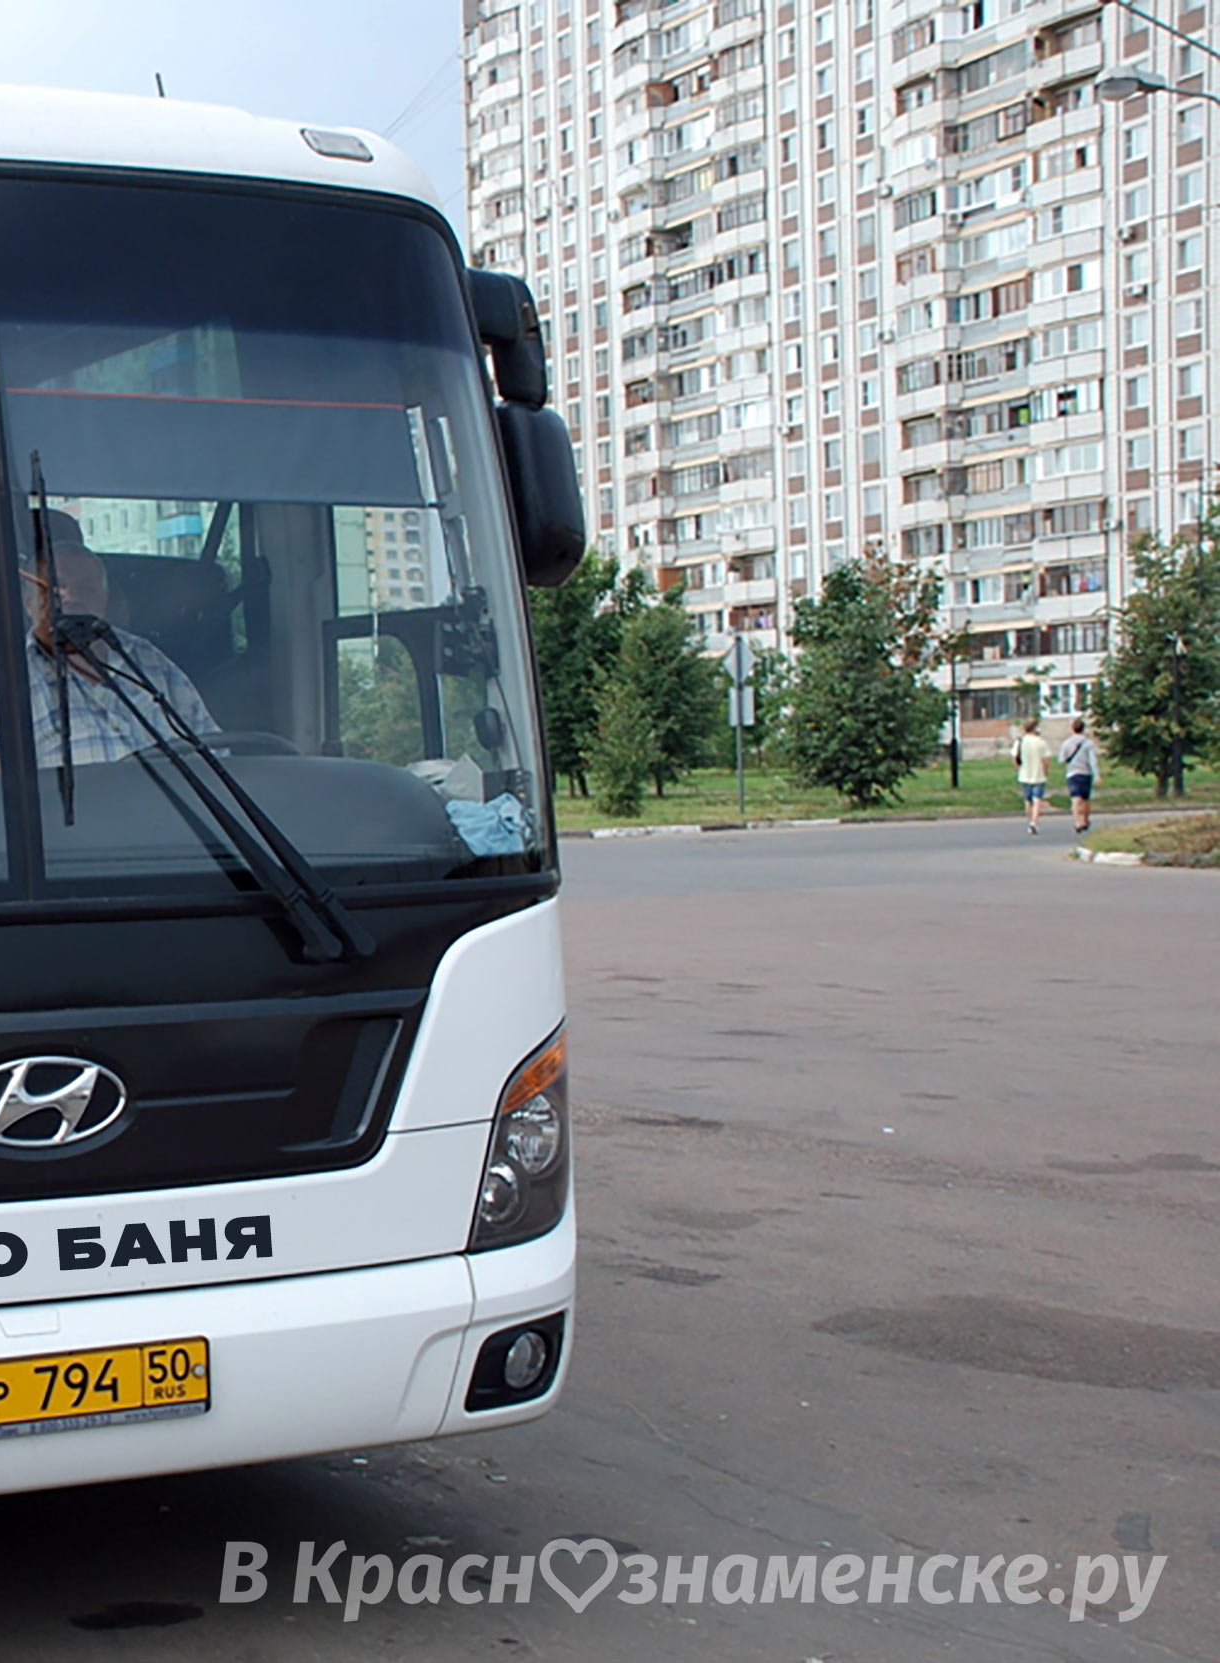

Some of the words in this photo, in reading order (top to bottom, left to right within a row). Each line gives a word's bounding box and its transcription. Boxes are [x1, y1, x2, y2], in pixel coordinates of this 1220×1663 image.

[57, 1214, 273, 1271] БАНЯ
[34, 1358, 119, 1411] 794
[148, 1348, 190, 1384] 50
[153, 1384, 187, 1400] RUS
